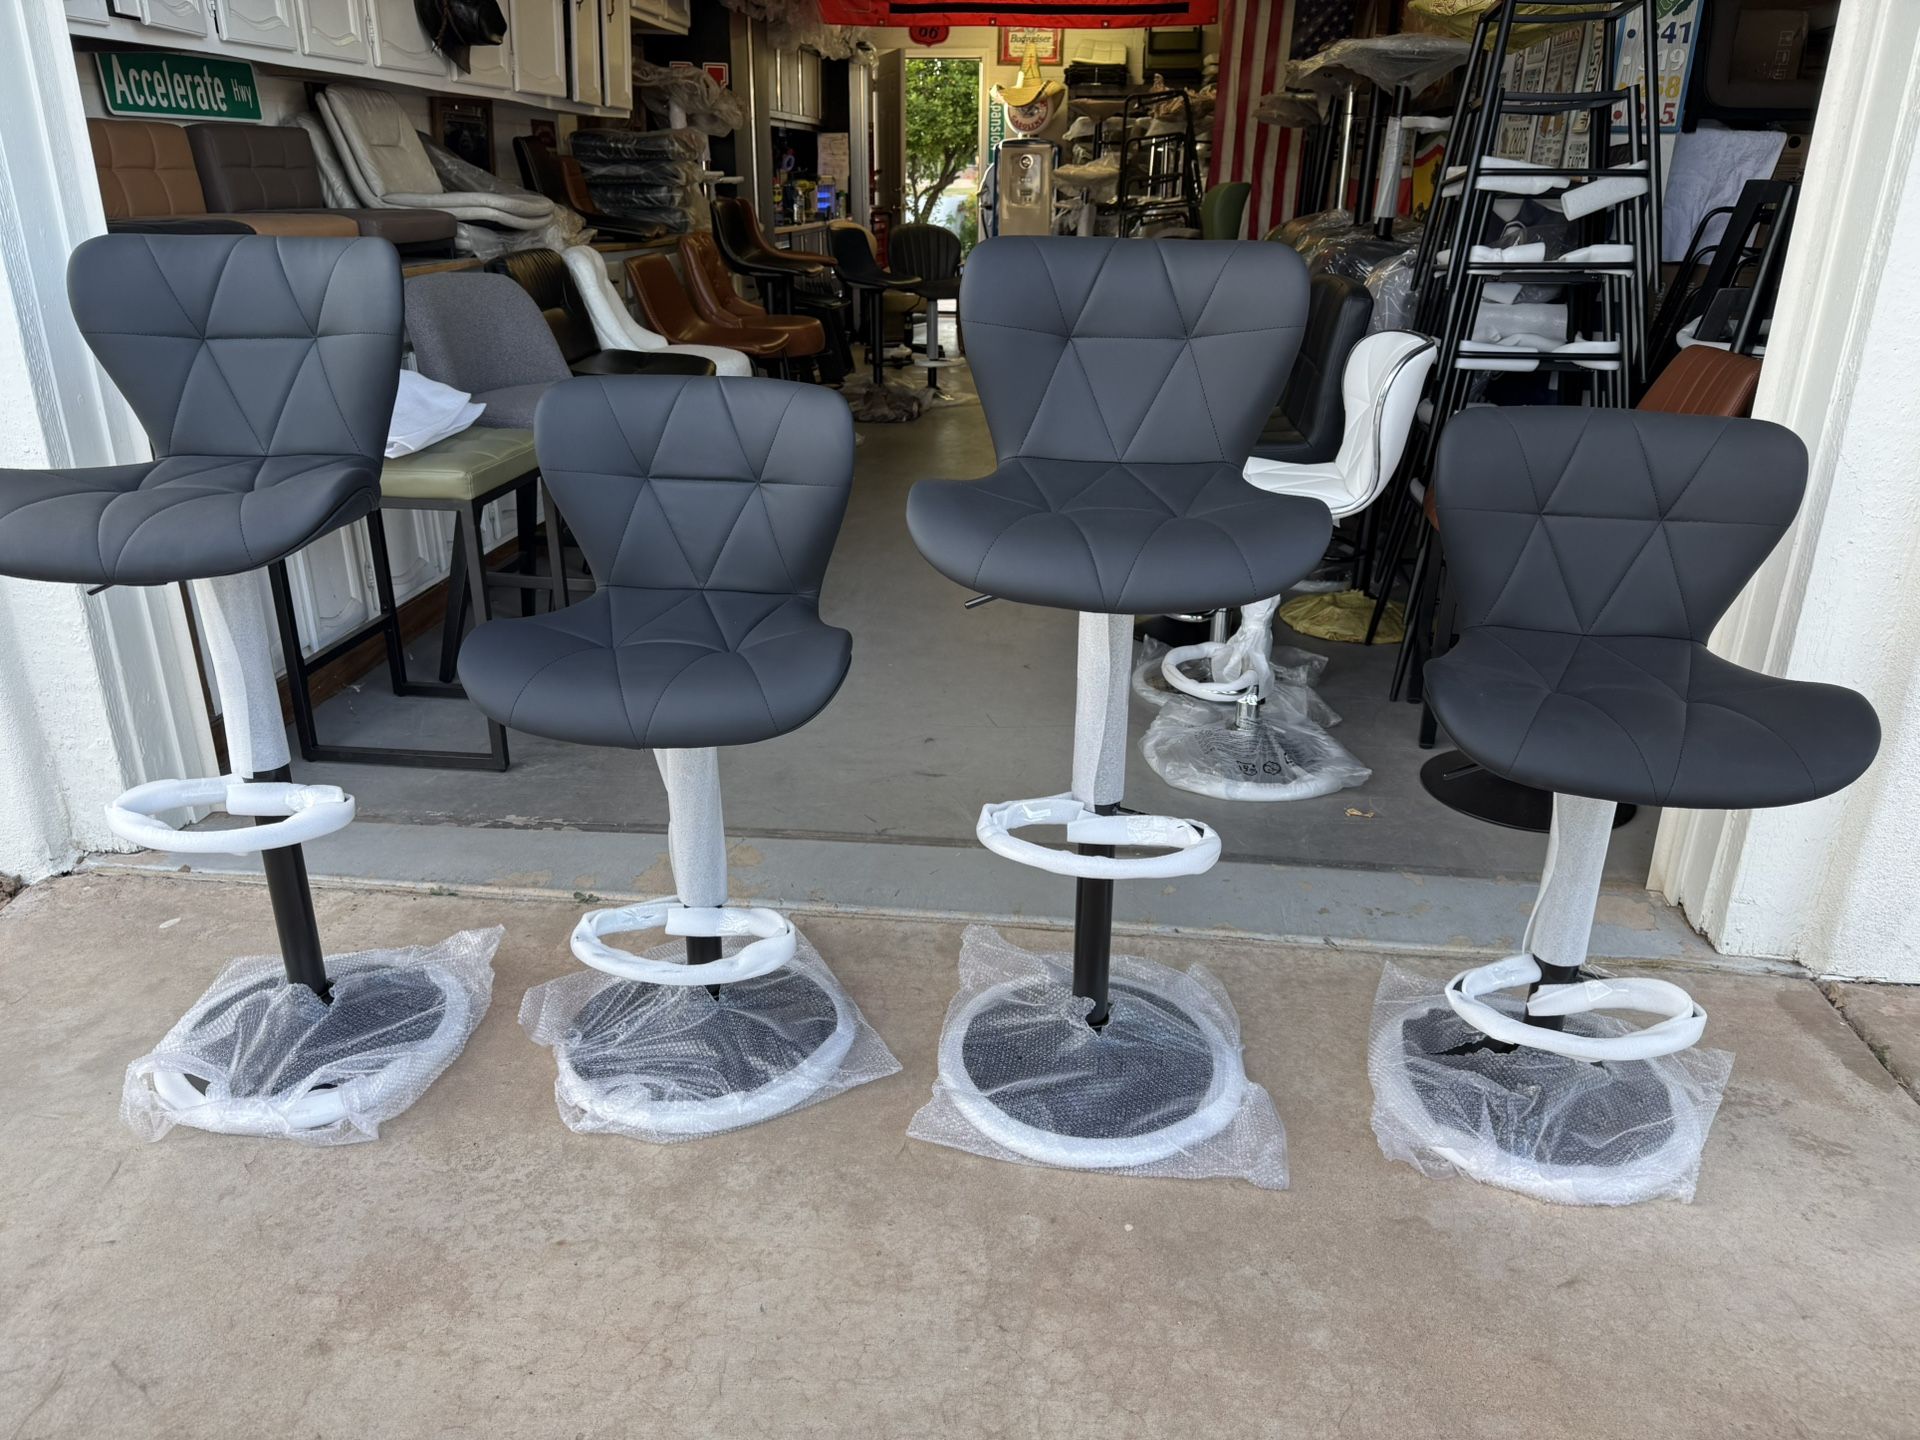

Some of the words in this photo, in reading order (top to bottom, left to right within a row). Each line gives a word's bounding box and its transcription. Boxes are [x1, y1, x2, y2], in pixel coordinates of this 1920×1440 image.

[1657, 21, 1692, 44] 41
[111, 54, 227, 112] Accelerate
[230, 78, 253, 109] Hwy
